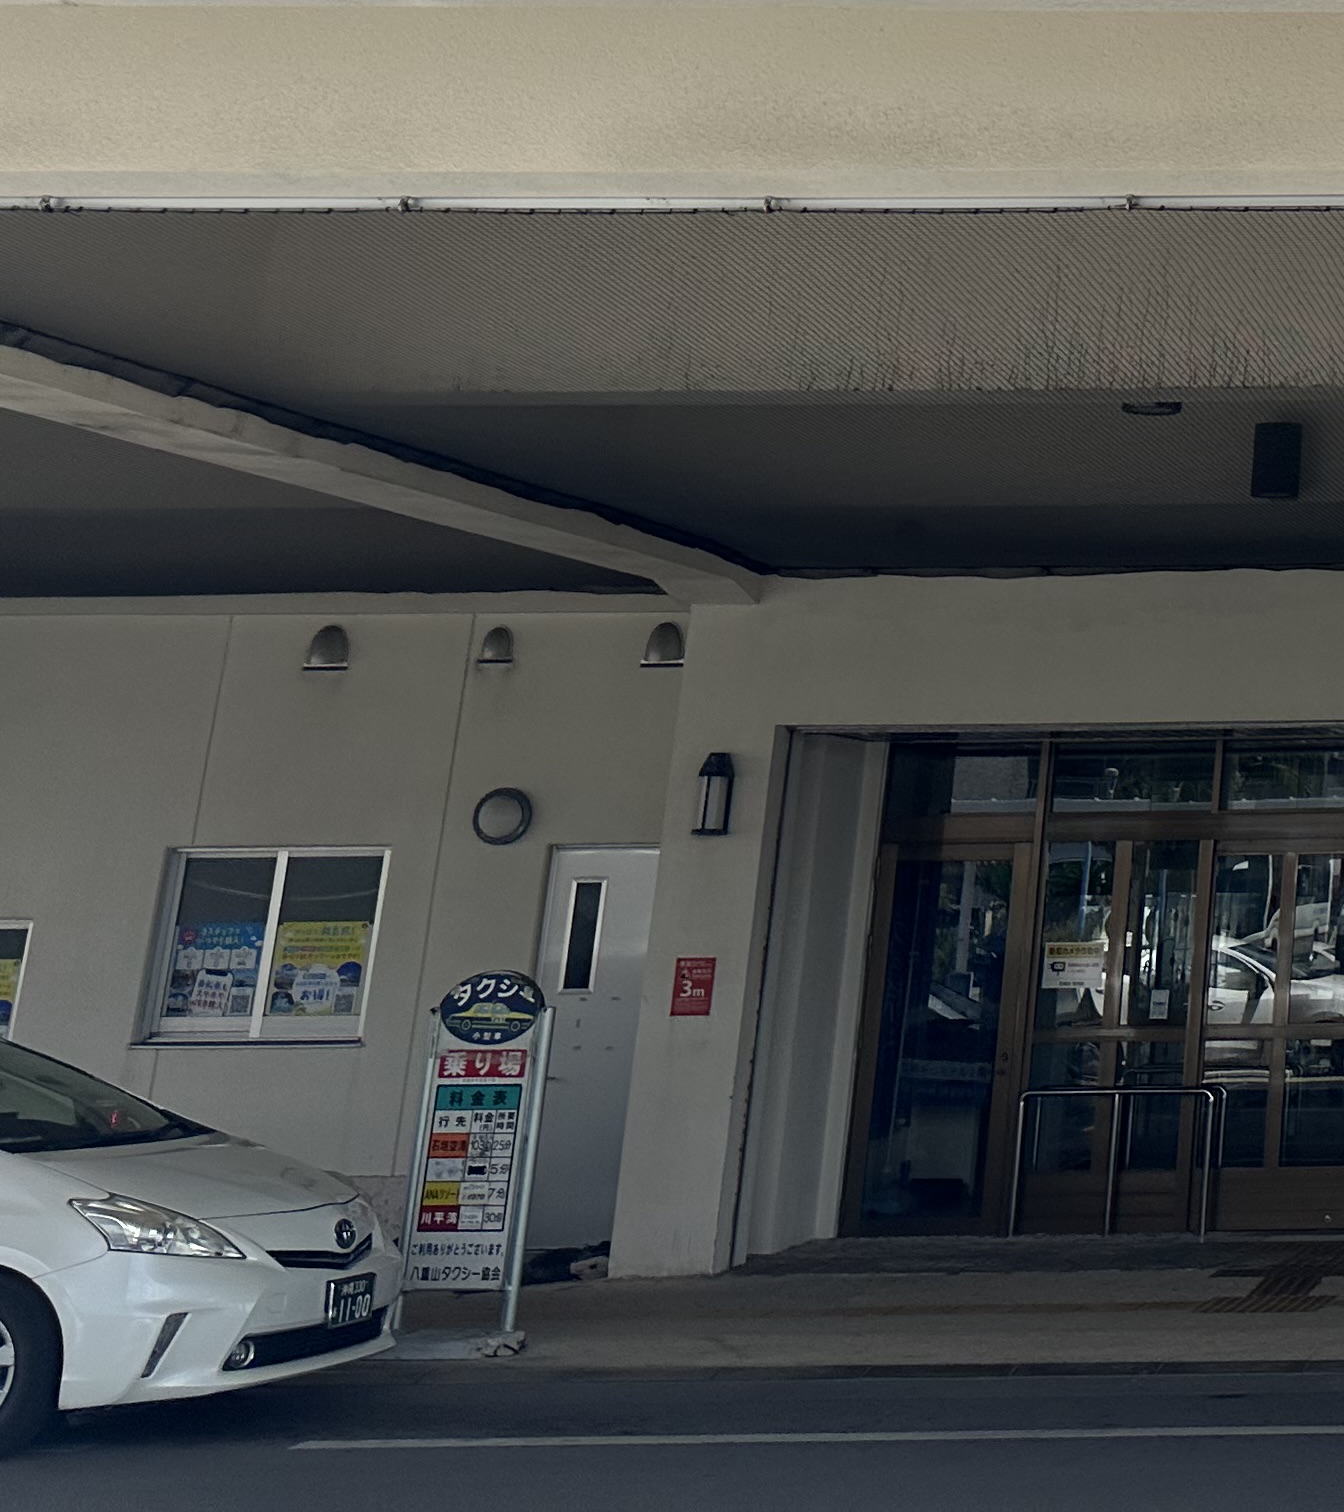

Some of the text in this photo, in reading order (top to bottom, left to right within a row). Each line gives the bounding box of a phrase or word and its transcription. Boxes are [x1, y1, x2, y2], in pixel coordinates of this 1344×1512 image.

[453, 978, 535, 1006] タクシー
[680, 980, 705, 997] 3m
[443, 1051, 522, 1076] 乗り場
[449, 1090, 507, 1106] 料金表
[438, 1116, 467, 1128] 行先
[474, 1112, 494, 1123] 料金
[410, 1266, 501, 1281] 八重山タクシー協会
